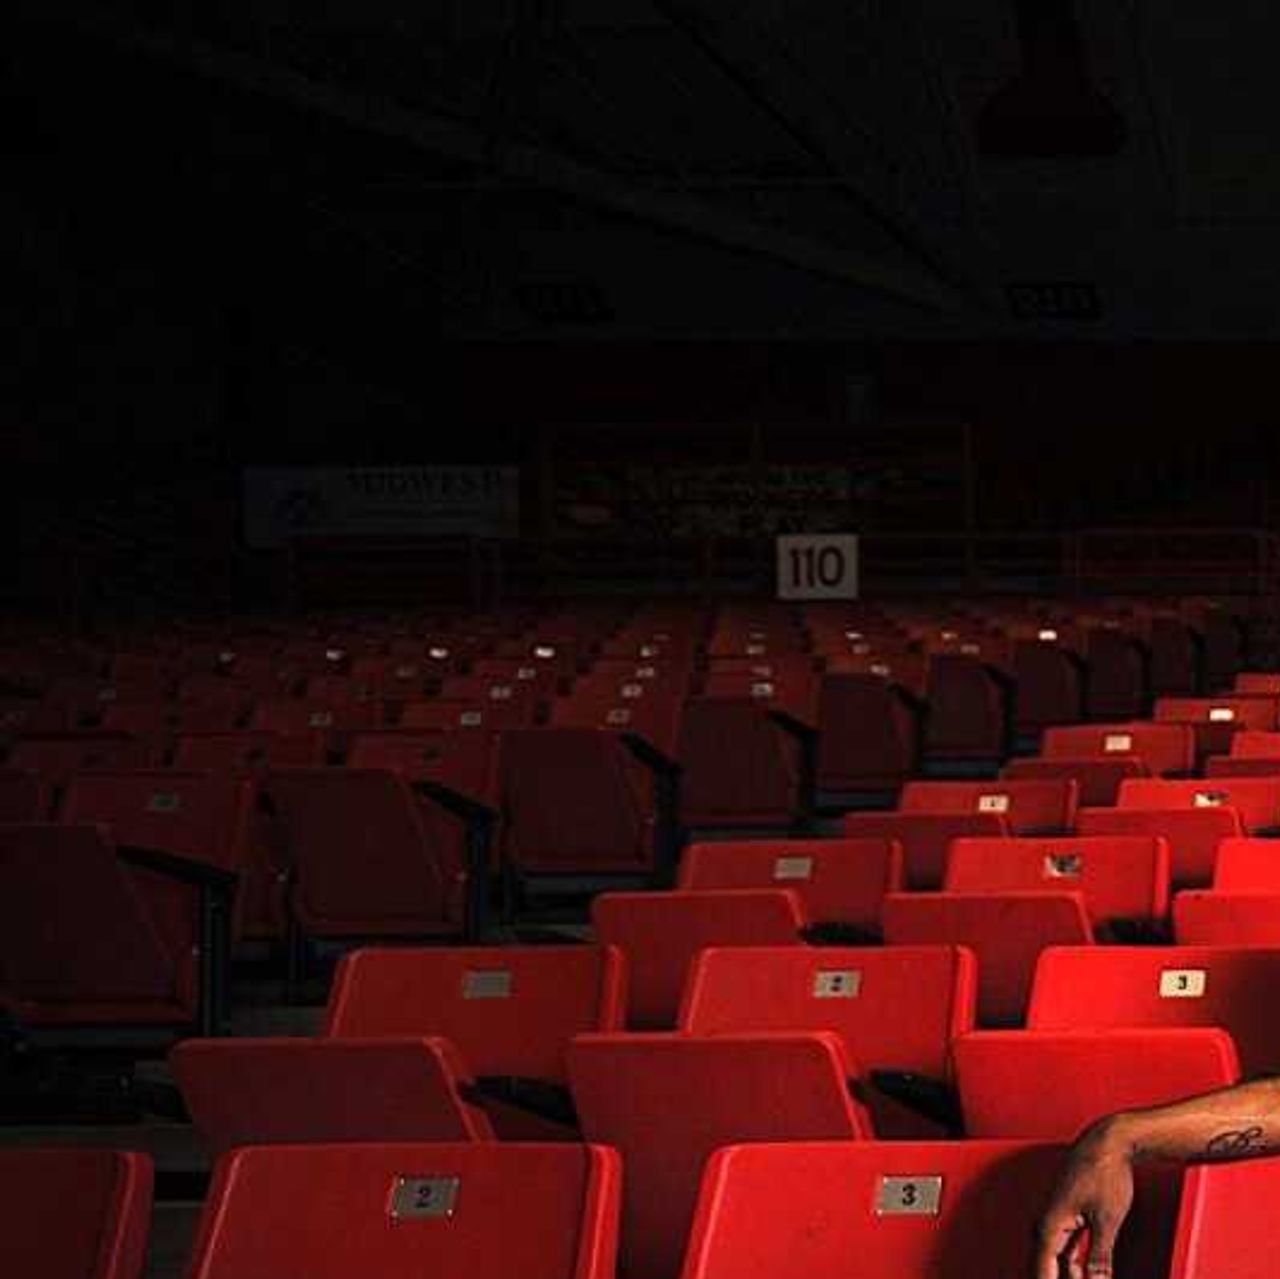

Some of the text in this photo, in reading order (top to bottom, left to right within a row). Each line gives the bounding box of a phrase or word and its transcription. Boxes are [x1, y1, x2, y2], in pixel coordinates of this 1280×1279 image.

[789, 546, 845, 588] 110
[414, 1185, 432, 1208] 2
[901, 1183, 917, 1207] 3
